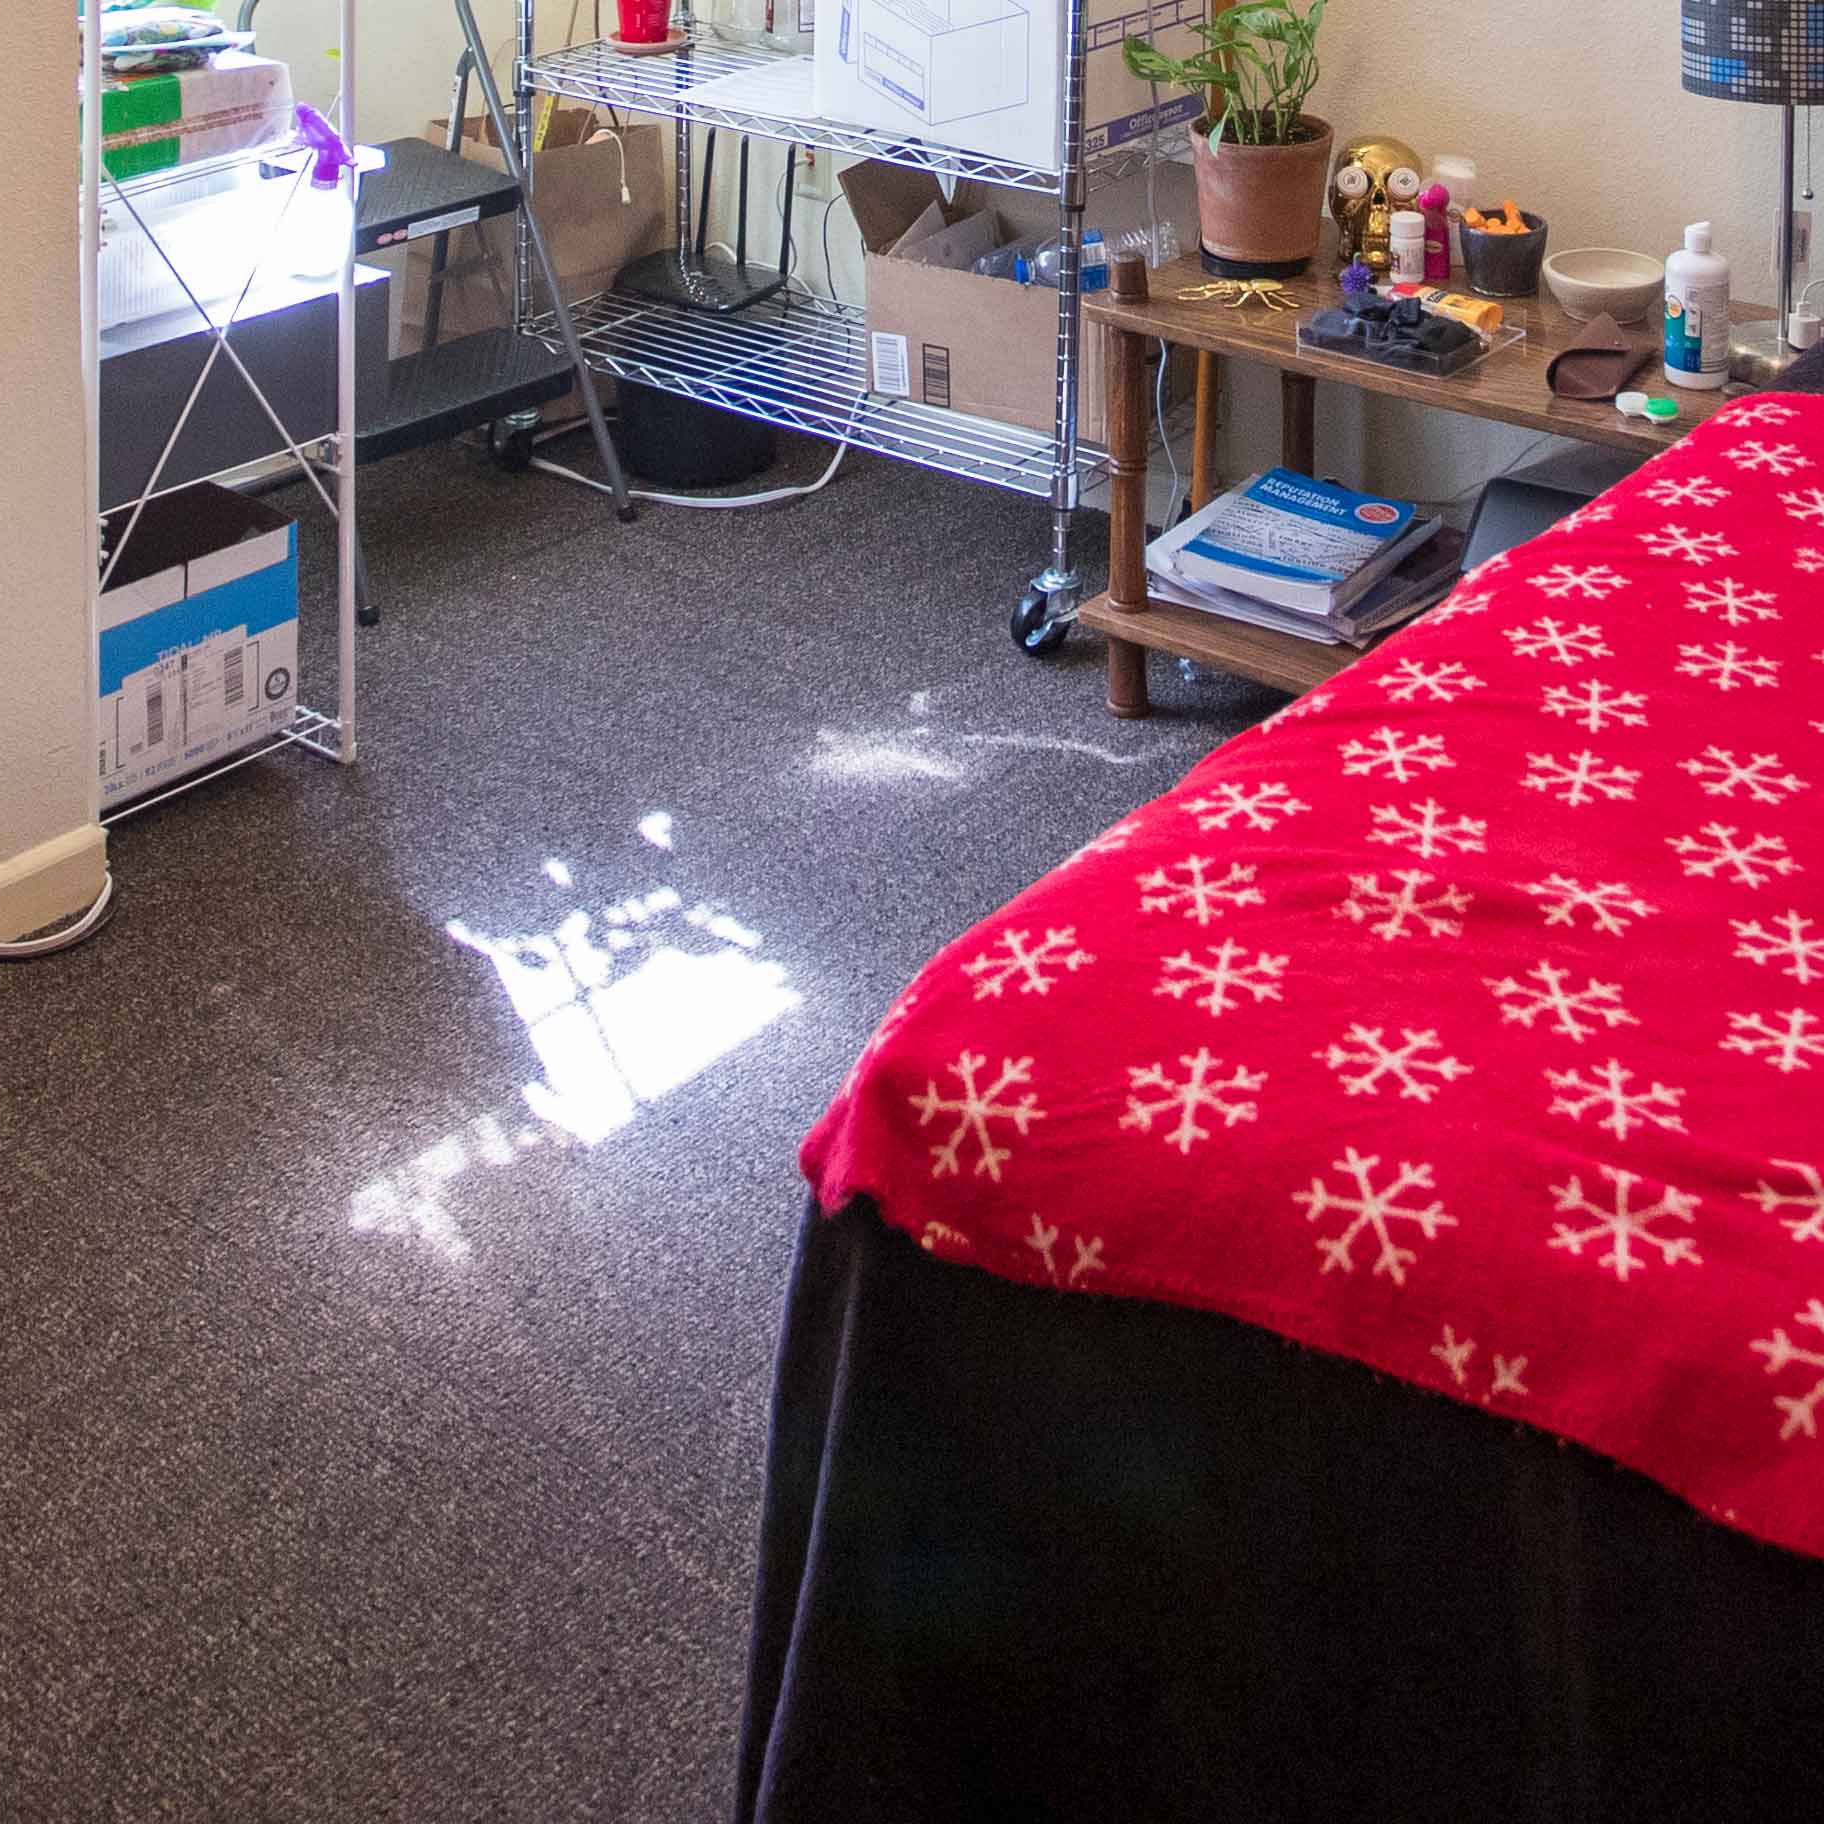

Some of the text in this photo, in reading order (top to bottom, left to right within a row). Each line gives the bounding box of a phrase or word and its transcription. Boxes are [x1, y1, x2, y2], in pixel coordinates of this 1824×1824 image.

[1129, 111, 1156, 129] Offic
[1259, 483, 1347, 517] MANAGEMENT
[1266, 477, 1340, 507] REPUTATION
